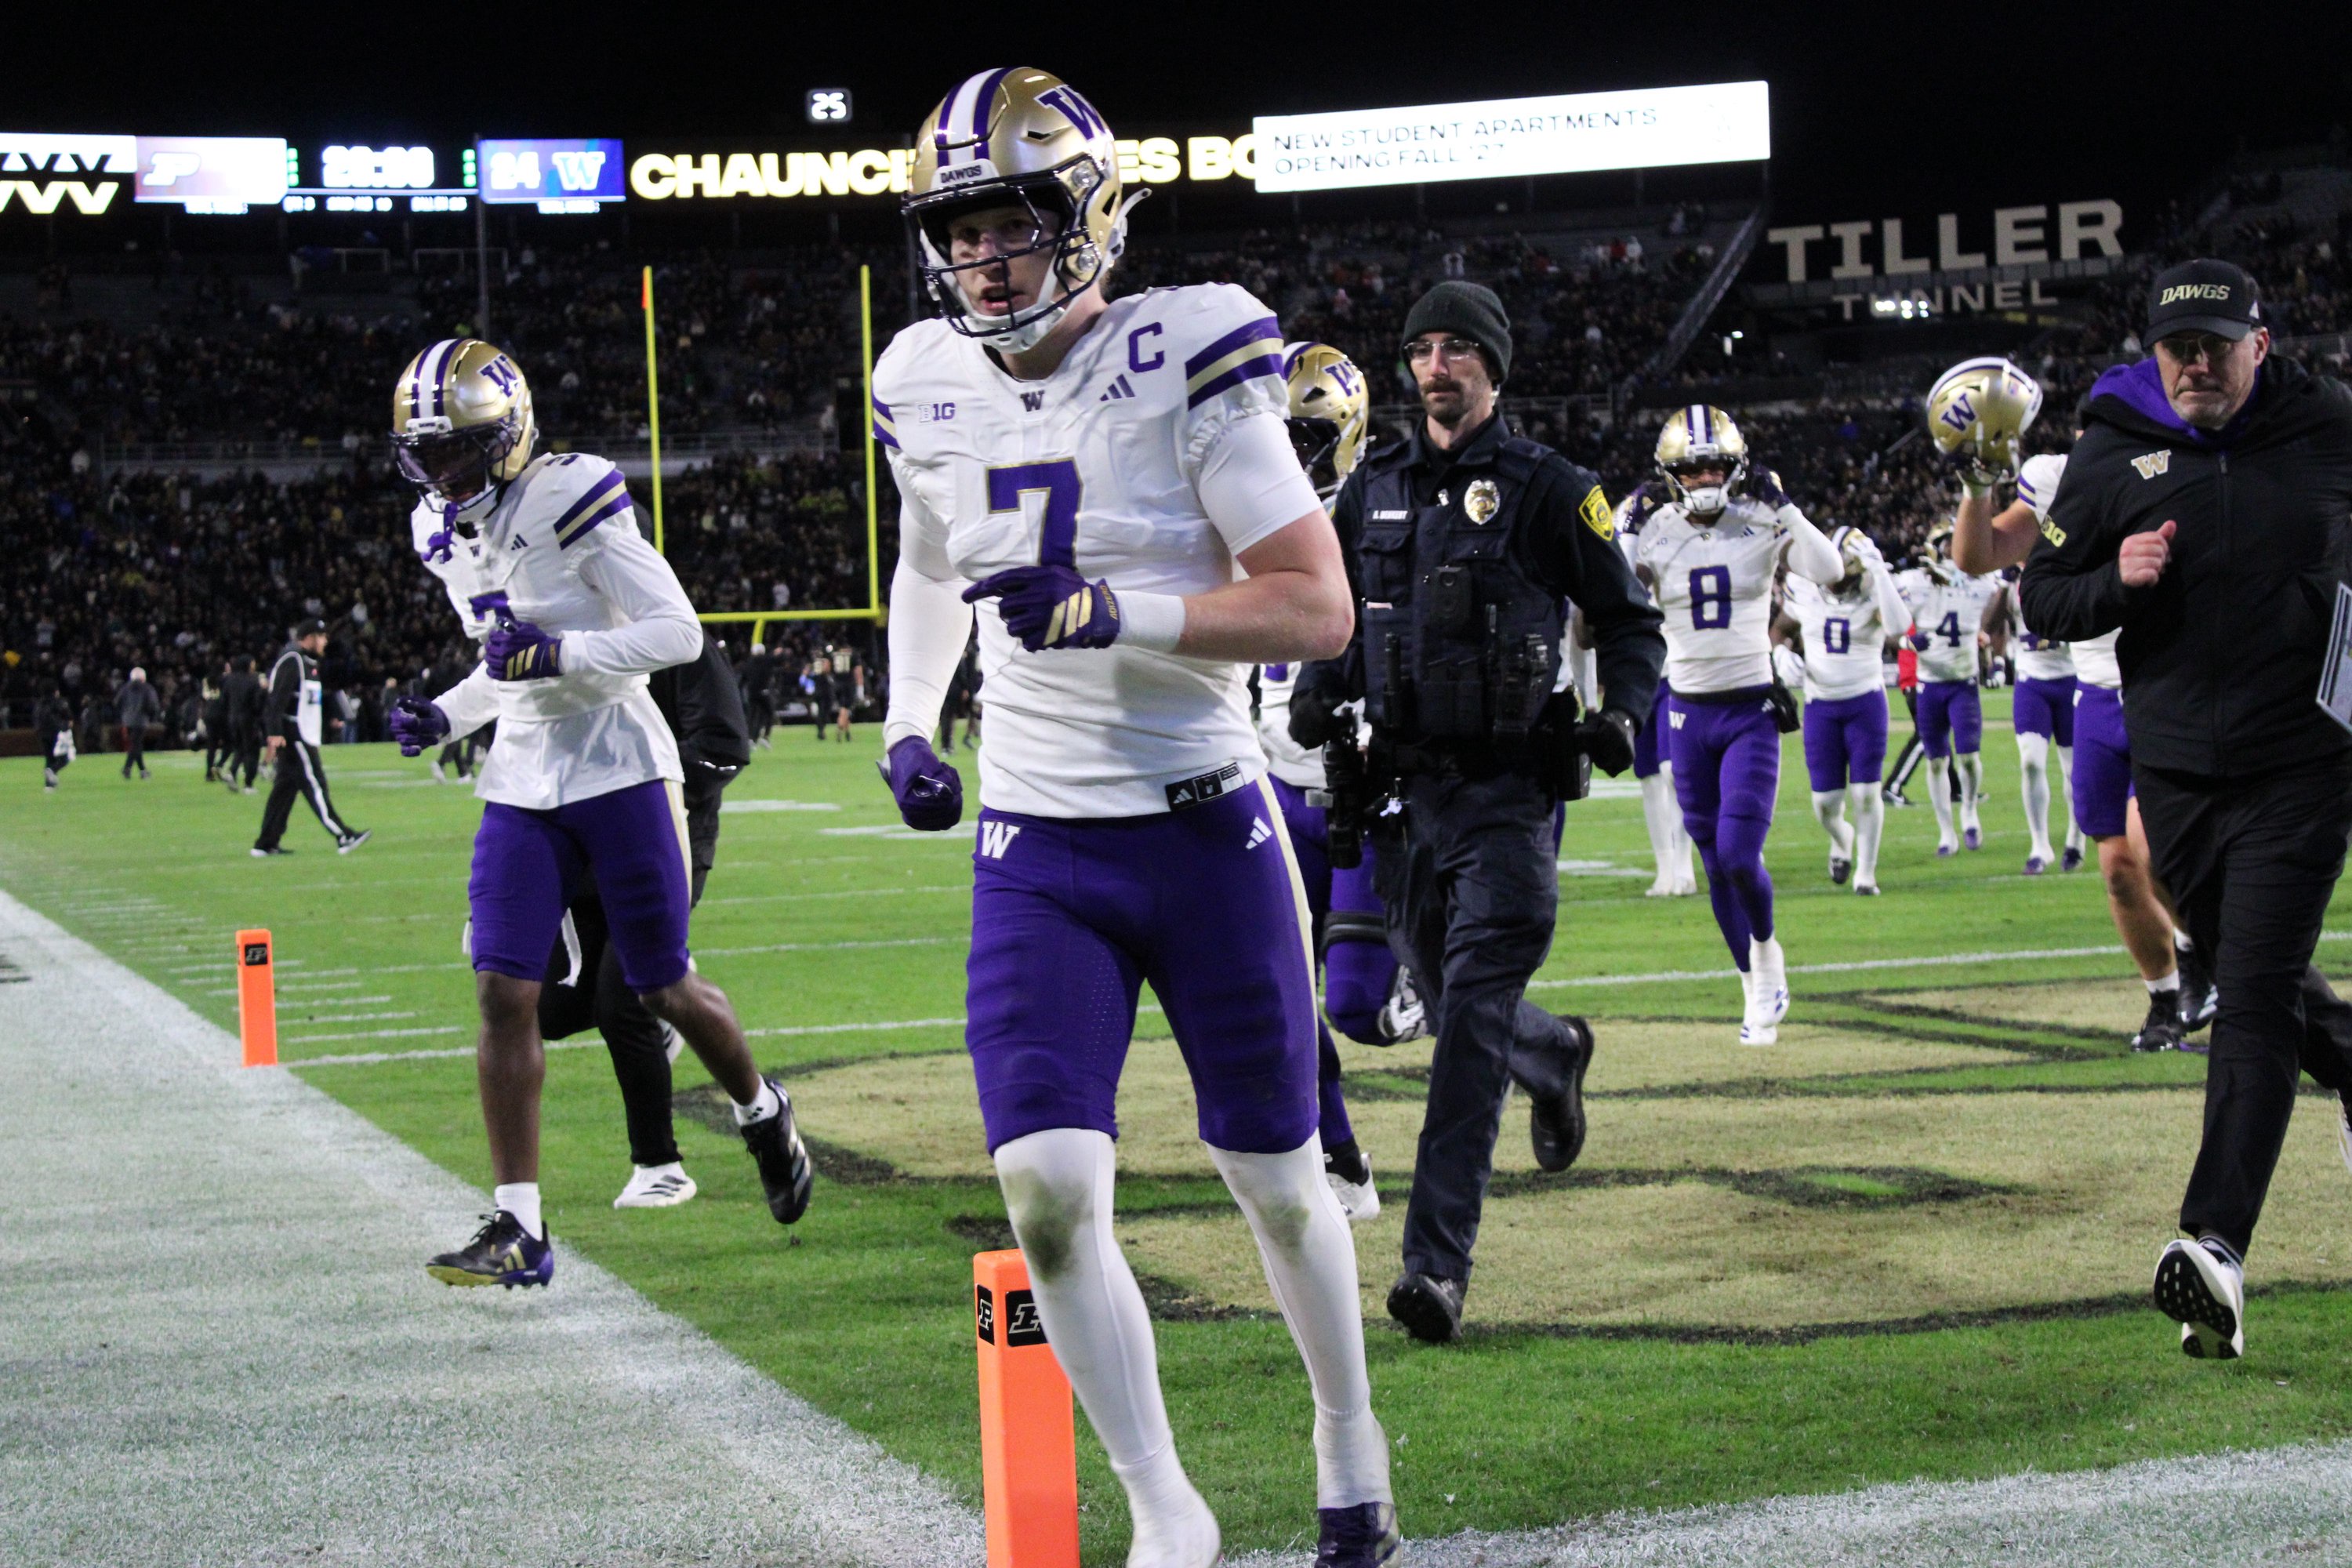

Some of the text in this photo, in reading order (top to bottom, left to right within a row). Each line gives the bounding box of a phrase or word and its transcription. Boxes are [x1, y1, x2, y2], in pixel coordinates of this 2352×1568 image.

[811, 92, 847, 120] 25
[1274, 108, 1657, 151] NEW STUDENT APARTMENTS
[552, 151, 606, 191] W
[630, 149, 916, 200] CHAUNCE
[1113, 136, 1181, 183] ES
[940, 165, 982, 183] DAWGS
[1275, 151, 1391, 174] OPENING
[1399, 147, 1461, 166] FALL
[1768, 198, 2124, 282] TILLER
[1832, 278, 2059, 321] TUNNEL
[2159, 283, 2231, 306] DAWGS
[1127, 321, 1165, 373] C
[477, 353, 521, 397] W
[1020, 390, 1045, 412] W
[1940, 393, 1976, 431] W
[2131, 449, 2172, 480] W
[985, 456, 1084, 570] 7
[1689, 564, 1732, 630] 8
[1824, 617, 1850, 654] 0
[1936, 611, 1962, 647] 4
[1669, 710, 1686, 730] W
[980, 821, 1022, 859] W
